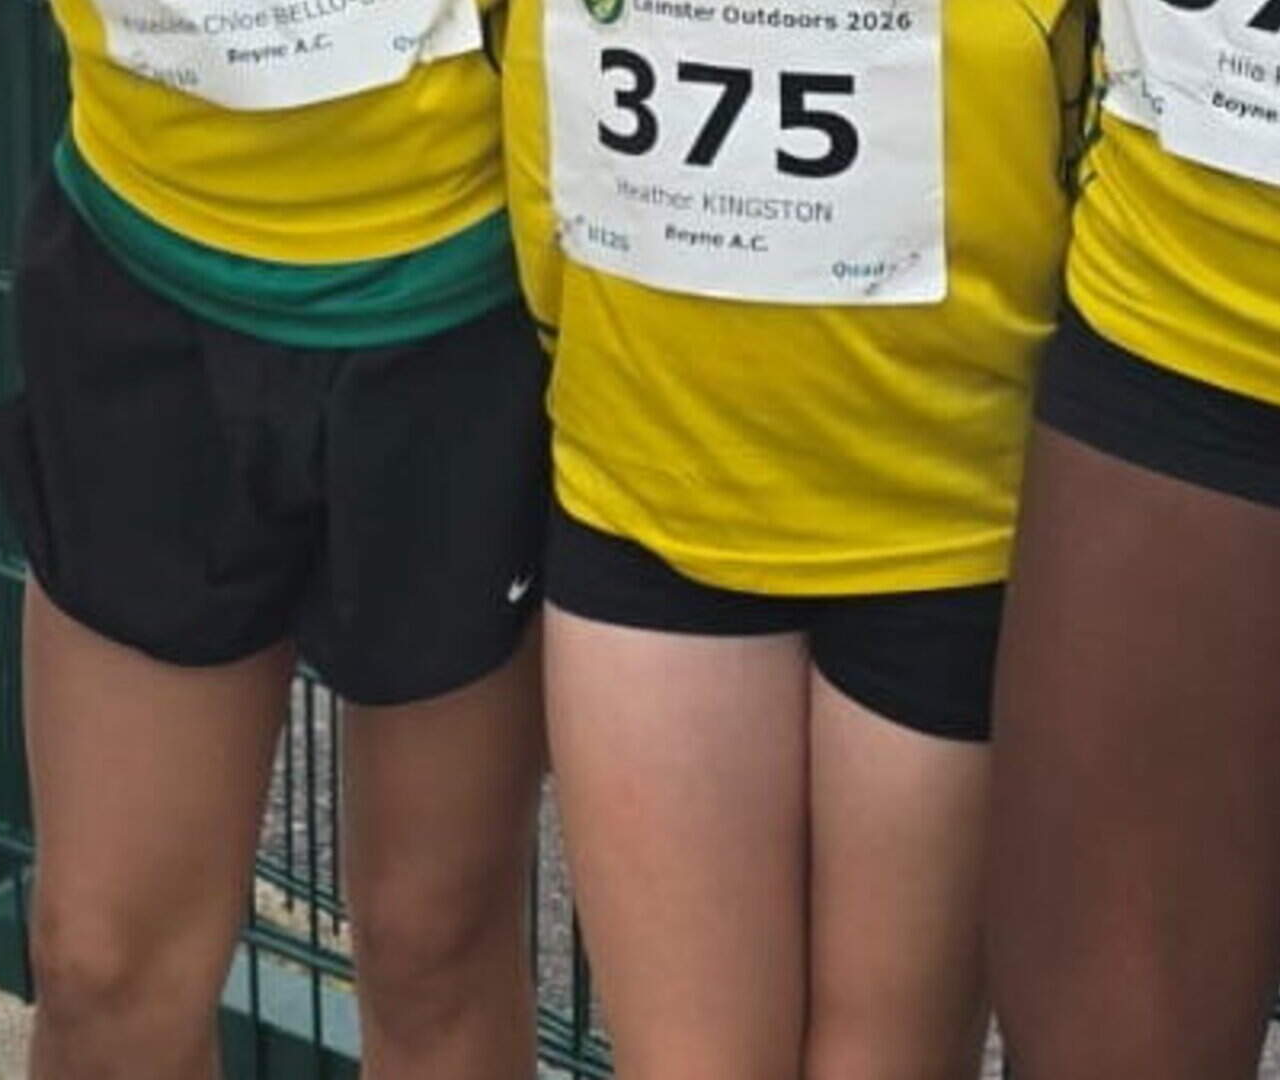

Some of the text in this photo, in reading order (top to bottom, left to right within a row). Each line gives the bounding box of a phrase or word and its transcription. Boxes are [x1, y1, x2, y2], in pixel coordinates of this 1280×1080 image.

[722, 6, 839, 31] Outdoors
[846, 10, 913, 31] 2026
[227, 32, 332, 65] Boyne A.C.
[597, 47, 860, 180] 375
[1211, 90, 1278, 123] Boyne
[702, 192, 834, 224] KINGSTON
[664, 223, 769, 253] Boyne A.C.
